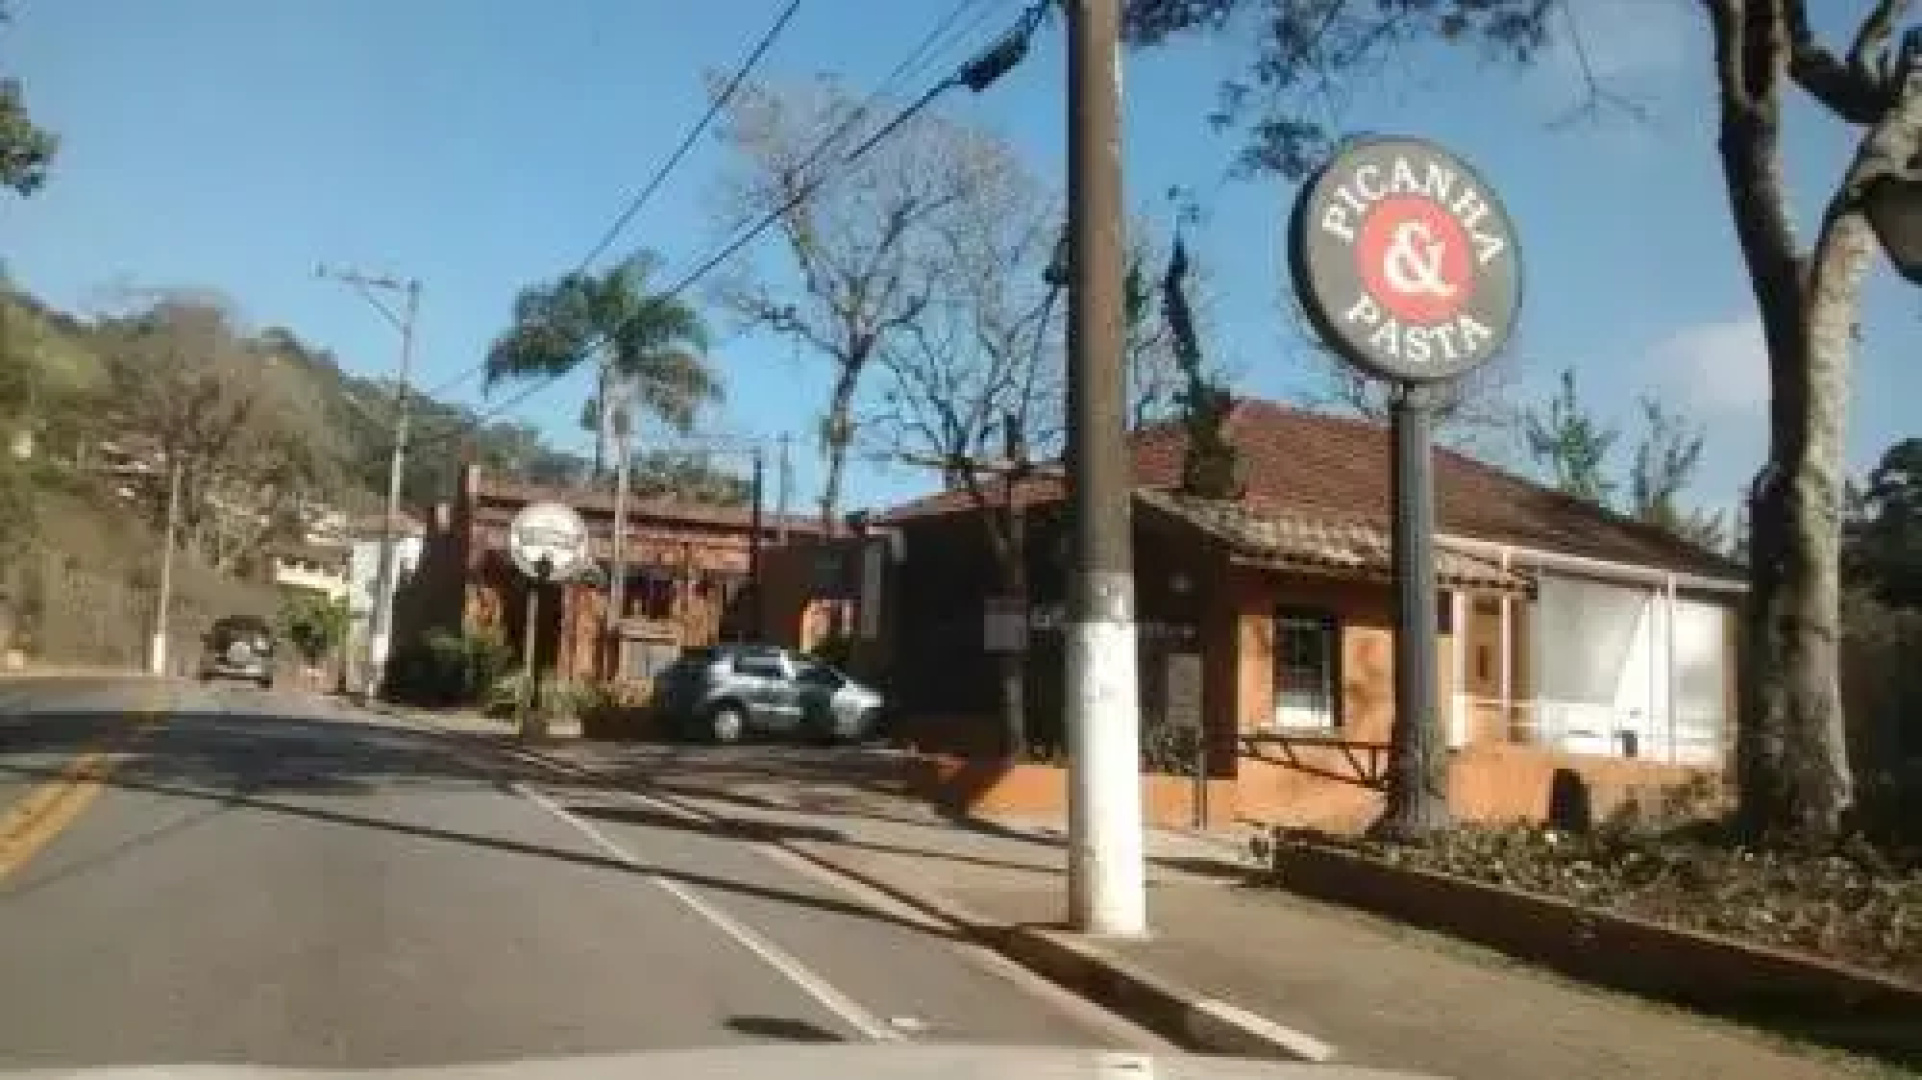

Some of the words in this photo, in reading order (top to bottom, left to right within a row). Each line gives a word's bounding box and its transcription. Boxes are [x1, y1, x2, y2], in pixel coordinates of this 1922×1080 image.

[1322, 156, 1504, 265] PICANHA
[1383, 220, 1458, 296] &
[1347, 292, 1493, 362] PASTA
